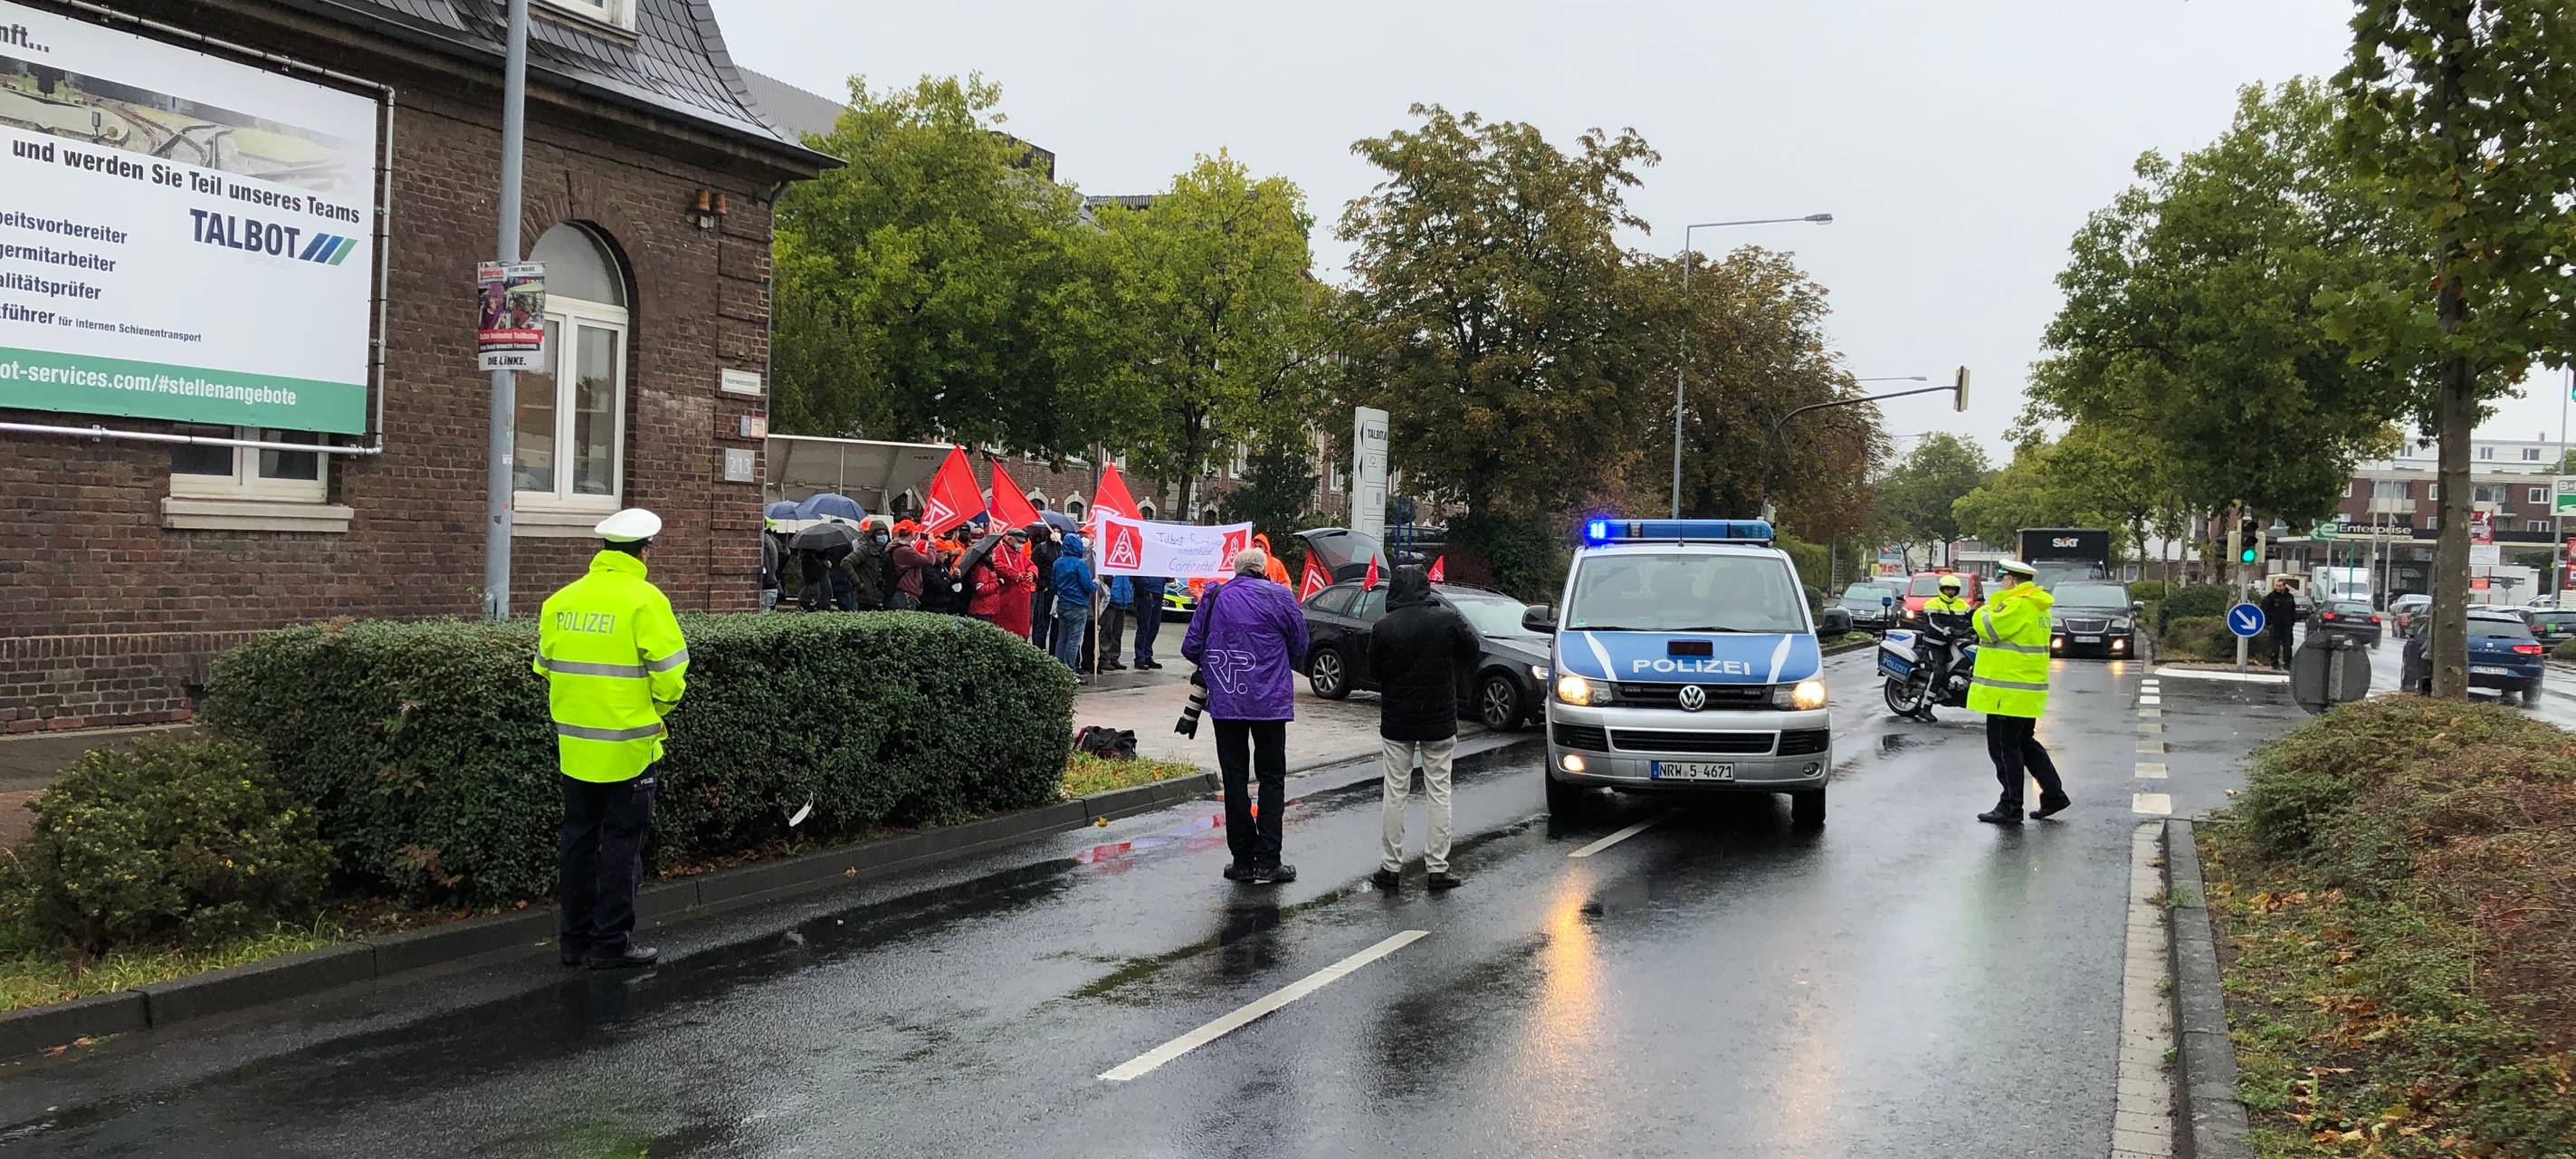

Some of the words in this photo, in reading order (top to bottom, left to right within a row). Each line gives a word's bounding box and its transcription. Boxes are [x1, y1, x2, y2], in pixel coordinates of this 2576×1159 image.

[13, 139, 54, 163] und
[63, 149, 143, 180] werden
[152, 163, 182, 188] Sie
[188, 170, 222, 196] Teil
[229, 183, 301, 212] unseres
[307, 196, 360, 225] Teams
[0, 211, 128, 244] eitsvorbereiter
[189, 207, 301, 258] TALBOT
[0, 303, 55, 324] führer
[58, 316, 72, 326] für
[76, 319, 116, 331] internen
[119, 323, 202, 343] Schienentransport
[488, 356, 498, 365] DIE
[1368, 428, 1384, 440] TALBOT
[730, 456, 751, 474] 213
[2340, 523, 2411, 535] Enterprise
[2053, 537, 2078, 548] SIXT
[557, 611, 615, 634] POLIZEI
[1633, 659, 1751, 675] POLIZEI
[1883, 656, 1908, 675] POLIZEI
[1660, 764, 1682, 777] NRW
